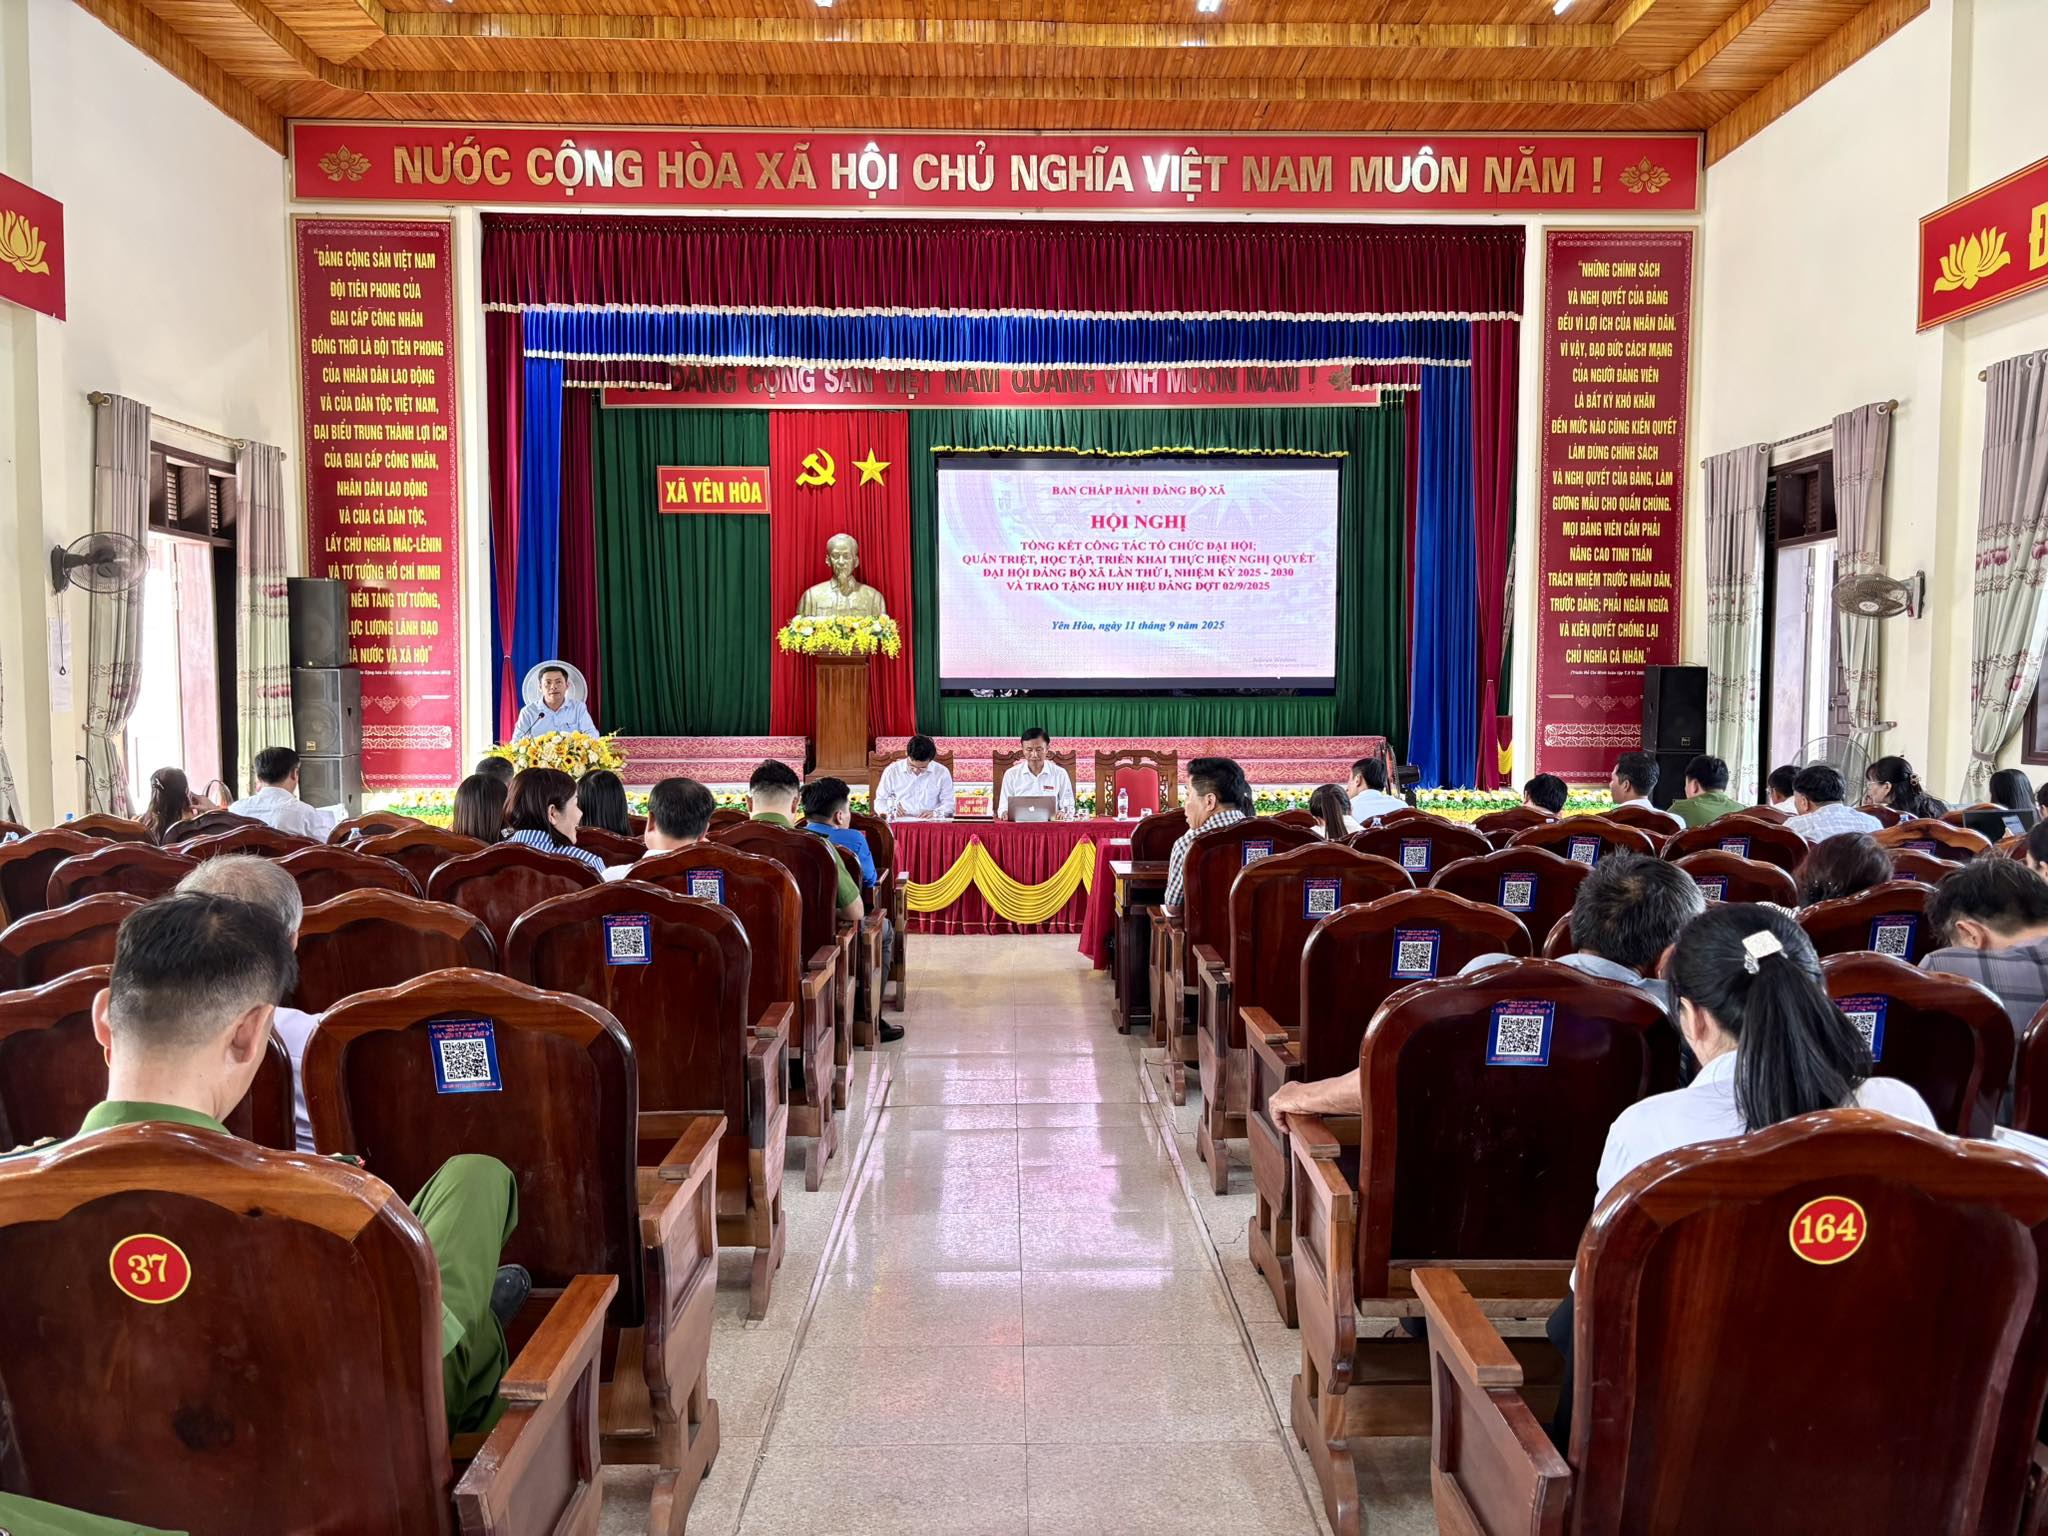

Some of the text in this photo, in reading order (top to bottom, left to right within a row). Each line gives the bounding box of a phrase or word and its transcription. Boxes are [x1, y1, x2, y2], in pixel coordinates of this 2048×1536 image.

[393, 137, 511, 186] NƯỚC
[526, 139, 644, 196] CỘNG
[659, 141, 744, 190] HÒA
[755, 143, 816, 190] XÃ
[831, 144, 897, 200] HỘI
[912, 140, 994, 192] CHỦ
[1011, 146, 1132, 192] NGHĨA
[1143, 147, 1228, 201] VIỆT
[1242, 156, 1332, 192] NAM
[1350, 147, 1468, 194] MUÔN
[1484, 145, 1575, 194] NĂM
[346, 246, 435, 271] CỘNG SẢN VIỆT NAM
[1612, 260, 1660, 277] CHÍNH SÁCH
[331, 277, 421, 300] ĐỘI TIÊN PHONG CỦA
[1568, 284, 1668, 308] VÀ NGHỊ QUYẾT CỦA ĐẢNG
[331, 305, 423, 327] GIAI CẤP CÔNG NHÂN
[1561, 339, 1672, 360] VÌ VẬY, ĐẠO ĐỨC CÁCH MẠNG
[323, 361, 434, 387] CỦA NHÂN DÂN LAO ĐỘNG
[945, 368, 1159, 395] NAM QUANG VINH
[1573, 362, 1659, 383] CỦA NGƯỜI ĐẢNG VIÊN
[320, 390, 439, 415] VÀ CỦA DÂN TỘC VIỆT NAM,
[1575, 392, 1584, 408] LÀ
[1587, 389, 1601, 408] BẤT
[1616, 392, 1631, 408] KHÓ
[314, 425, 329, 442] ĐẠI
[354, 425, 383, 440] TRUNG
[386, 422, 413, 440] THÀNH
[417, 424, 430, 444] LỢI
[433, 422, 447, 440] ÍCH
[1552, 415, 1567, 433] ĐẾN
[1570, 416, 1587, 434] MỨC
[1590, 417, 1606, 434] NÀO
[1632, 417, 1650, 434] KIÊN
[1652, 416, 1677, 436] QUYẾT
[325, 447, 439, 470] CỦA GIAI CẤP CÔNG NHÂN,
[1569, 443, 1658, 460] LÀM ĐÚNG CHÍNH SÁCH
[1553, 466, 1673, 488] VÀ NGHỊ QUYẾT CỦA ĐẢNG, LÀM
[337, 478, 427, 499] NHÂN DÂN LAO ĐỘNG
[666, 476, 762, 503] XÃ YÊN HÒA
[1052, 487, 1078, 495] BAN
[1115, 485, 1149, 495] HÀNH
[1190, 486, 1206, 497] BỘ
[1209, 485, 1225, 495] XÃ
[339, 503, 426, 527] VÀ CỦA CẢ DÂN TỘC,
[1091, 513, 1187, 531] HỘI NGHỊ
[326, 532, 341, 552] LẤY
[344, 531, 361, 552] CHỦ
[364, 534, 391, 552] NGHĨA
[1041, 556, 1166, 566] HỌC KHAI
[1594, 548, 1609, 561] CAO
[1612, 548, 1629, 562] TINH
[1007, 582, 1022, 591] VÀ
[1026, 583, 1058, 591] TRAO
[1098, 583, 1123, 591] HUY
[1127, 582, 1156, 592] HIỆU
[1196, 582, 1220, 592] ĐỢT
[1223, 582, 1270, 591] 02/9/2025
[1052, 621, 1224, 631] Yên Hòa, ngày 11 tháng 9 năm 2025
[1560, 620, 1569, 637] VÀ
[1572, 621, 1589, 637] KIÊN
[1592, 619, 1616, 639] QUYẾT
[1647, 624, 1658, 640] LẠI
[1566, 644, 1620, 663] CHỦ NGHĨA CÁ
[1799, 1213, 1857, 1244] 164
[128, 1253, 167, 1284] 37
